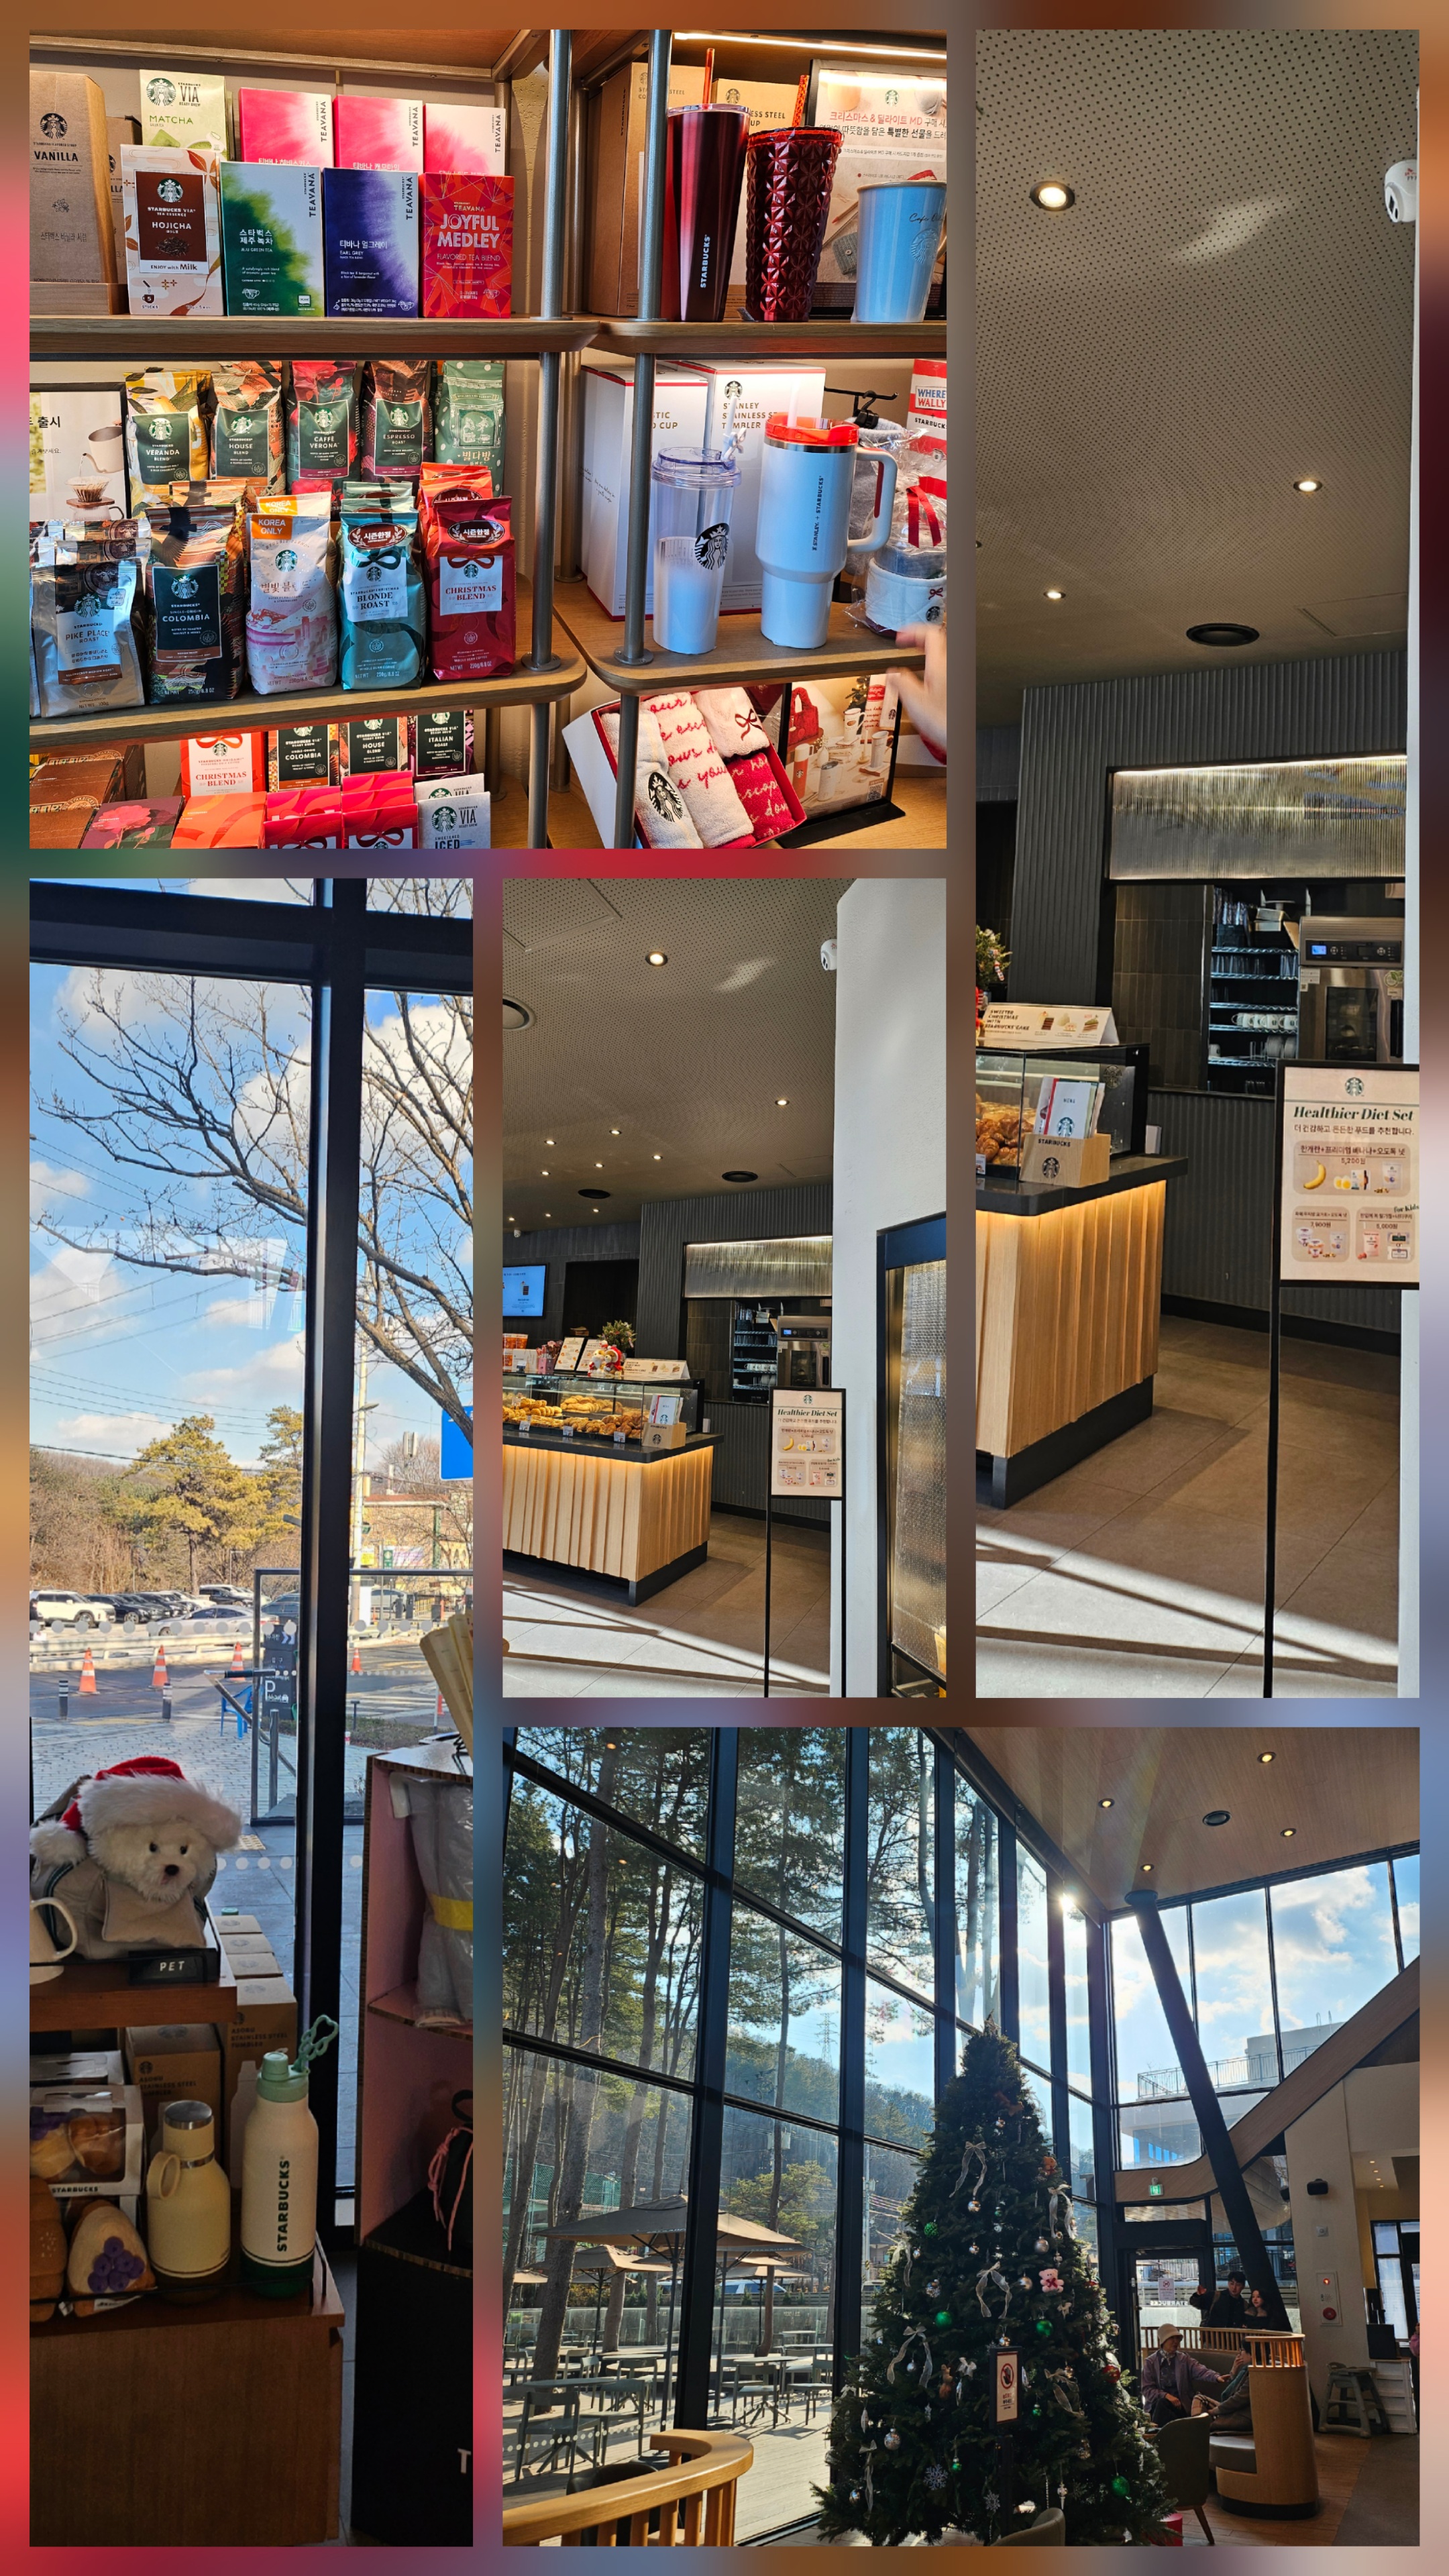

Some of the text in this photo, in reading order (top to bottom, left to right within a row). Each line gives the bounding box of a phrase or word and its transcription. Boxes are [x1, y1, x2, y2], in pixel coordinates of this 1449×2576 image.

[180, 86, 199, 102] VIA
[149, 115, 193, 125] MATCHA
[830, 111, 869, 122] 크리스마스
[878, 116, 908, 125] 딜라이트
[910, 117, 922, 125] MD
[925, 118, 937, 127] 구매
[842, 126, 870, 136] 따뜻함을
[872, 127, 885, 136] 담은
[887, 127, 909, 138] 특별한
[911, 129, 932, 139] 선물을
[34, 151, 78, 161] VANILLA
[440, 214, 499, 231] JOYFUL
[258, 237, 273, 245] 녹차
[340, 240, 359, 248] 티바나
[437, 232, 500, 248] MEDLEY
[700, 234, 710, 288] STARBUCKS
[918, 388, 946, 399] WHERE
[918, 398, 946, 408] WALLY
[38, 416, 61, 428] 출시
[463, 451, 491, 461] 별다방
[364, 531, 391, 540] 시즌한정
[261, 582, 279, 593] 별빛
[445, 585, 496, 594] CHRISTMAS
[357, 592, 393, 602] BLONDE
[361, 601, 389, 610] ROAST
[162, 614, 210, 622] COLOMBIA
[66, 631, 83, 641] PIKE
[196, 771, 247, 780] CHRISTMAS
[460, 809, 476, 824] VIA
[435, 839, 460, 849] ICED
[1294, 1107, 1414, 1121] Healthier Diet Set
[1038, 1139, 1070, 1147] STARBUCKS
[265, 1680, 276, 1701] P
[160, 1960, 185, 1972] PET
[277, 2160, 290, 2253] STARBUCKS
